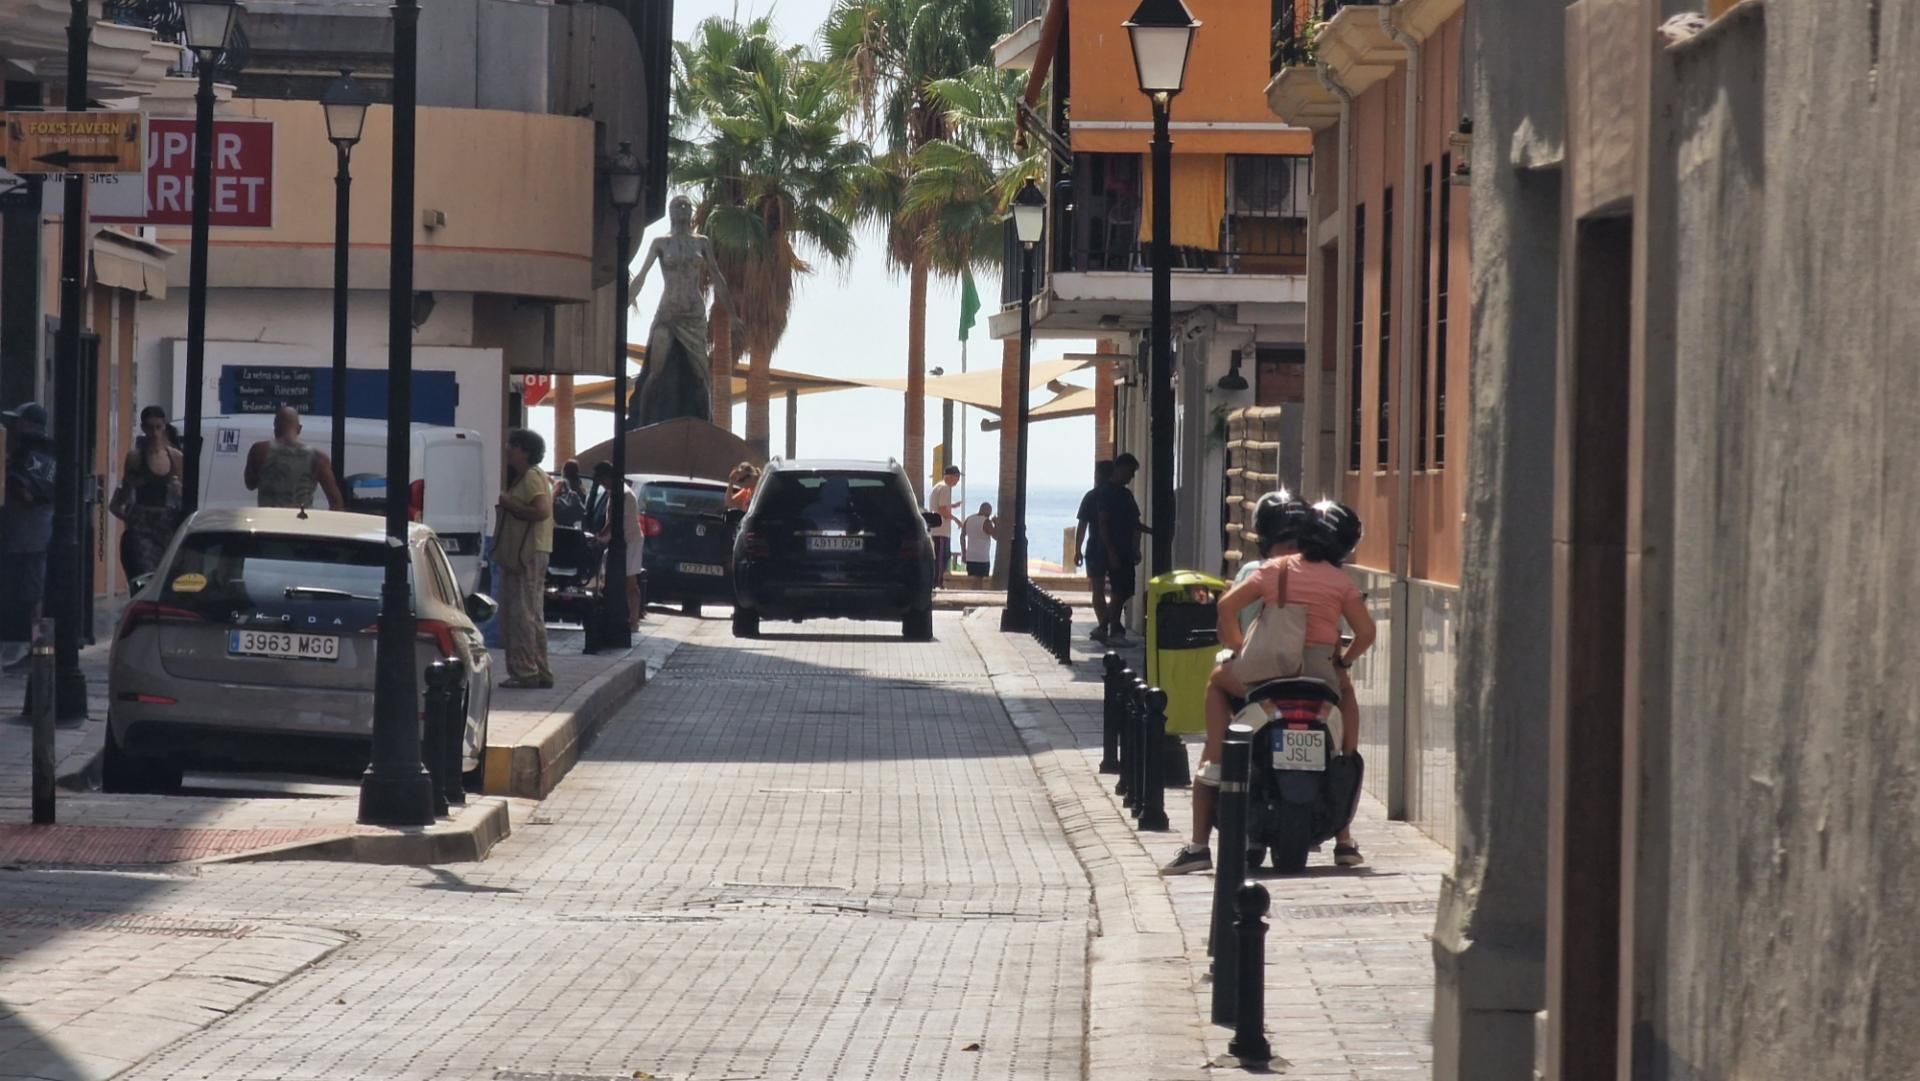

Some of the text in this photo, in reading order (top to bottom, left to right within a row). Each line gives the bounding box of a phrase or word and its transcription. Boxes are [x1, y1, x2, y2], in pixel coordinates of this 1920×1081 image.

[30, 122, 120, 135] FOX'S TAVERN
[244, 633, 292, 652] 3963
[1286, 732, 1322, 748] 6005
[1286, 748, 1313, 762] JSL
